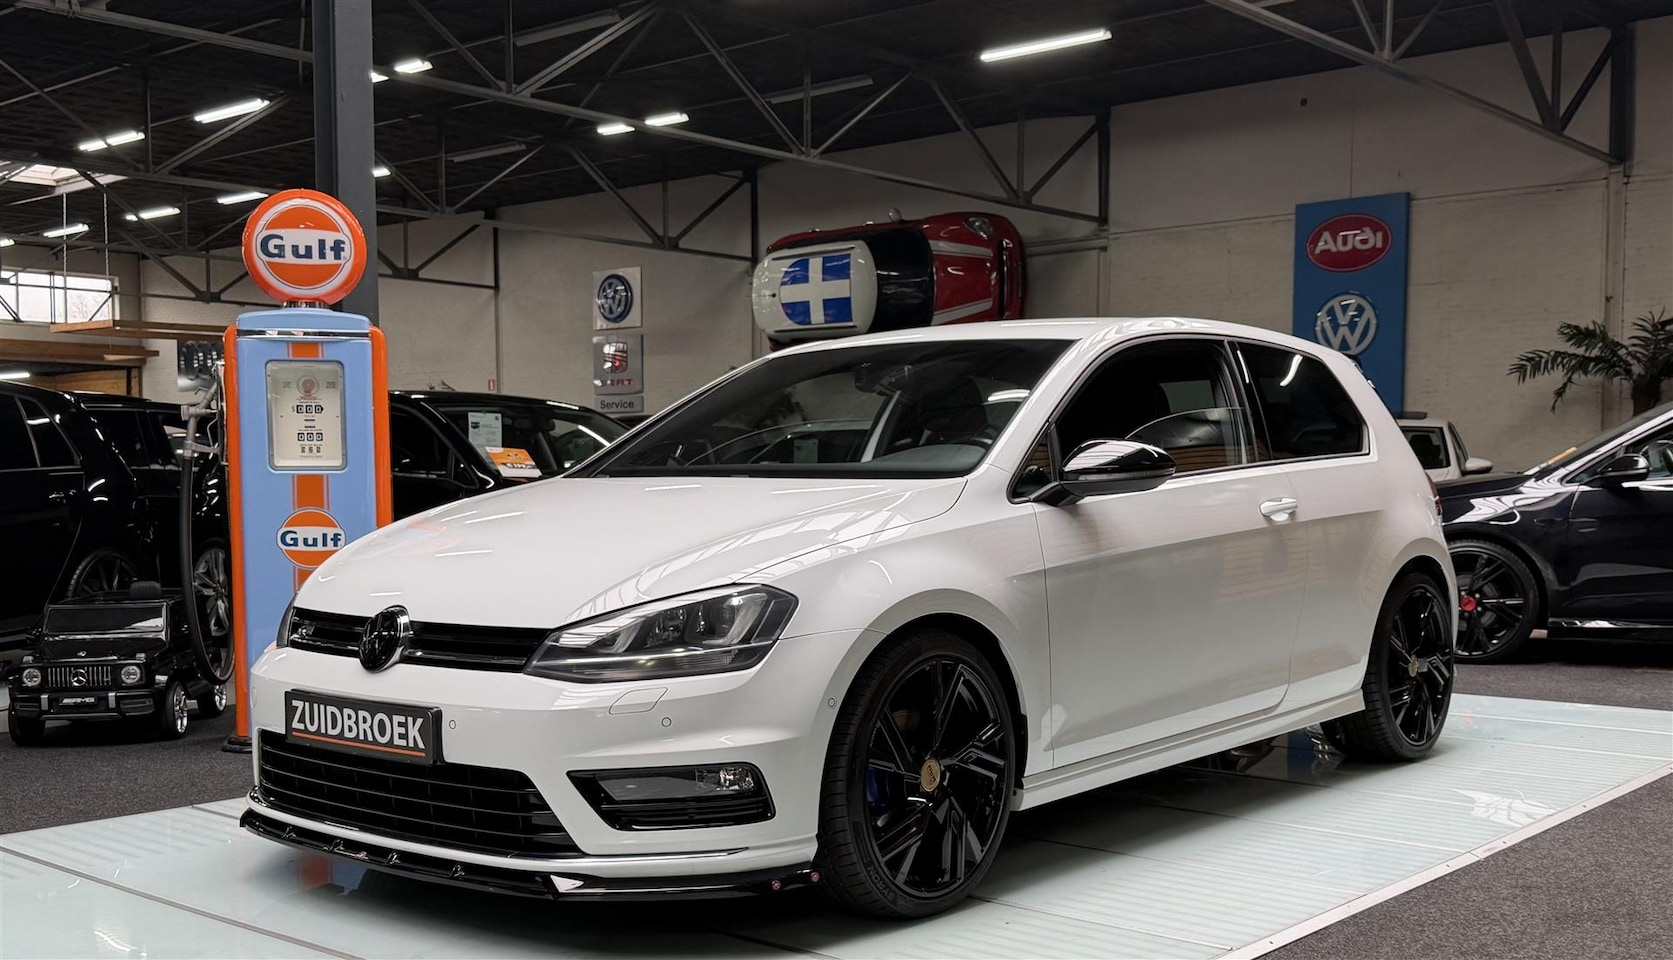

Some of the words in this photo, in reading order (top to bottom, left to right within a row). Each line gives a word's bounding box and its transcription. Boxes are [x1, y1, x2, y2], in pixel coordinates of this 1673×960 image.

[260, 233, 346, 261] Gulf
[600, 399, 634, 409] Service
[280, 530, 342, 547] Gulf
[291, 699, 426, 750] ZUIDBROEK
